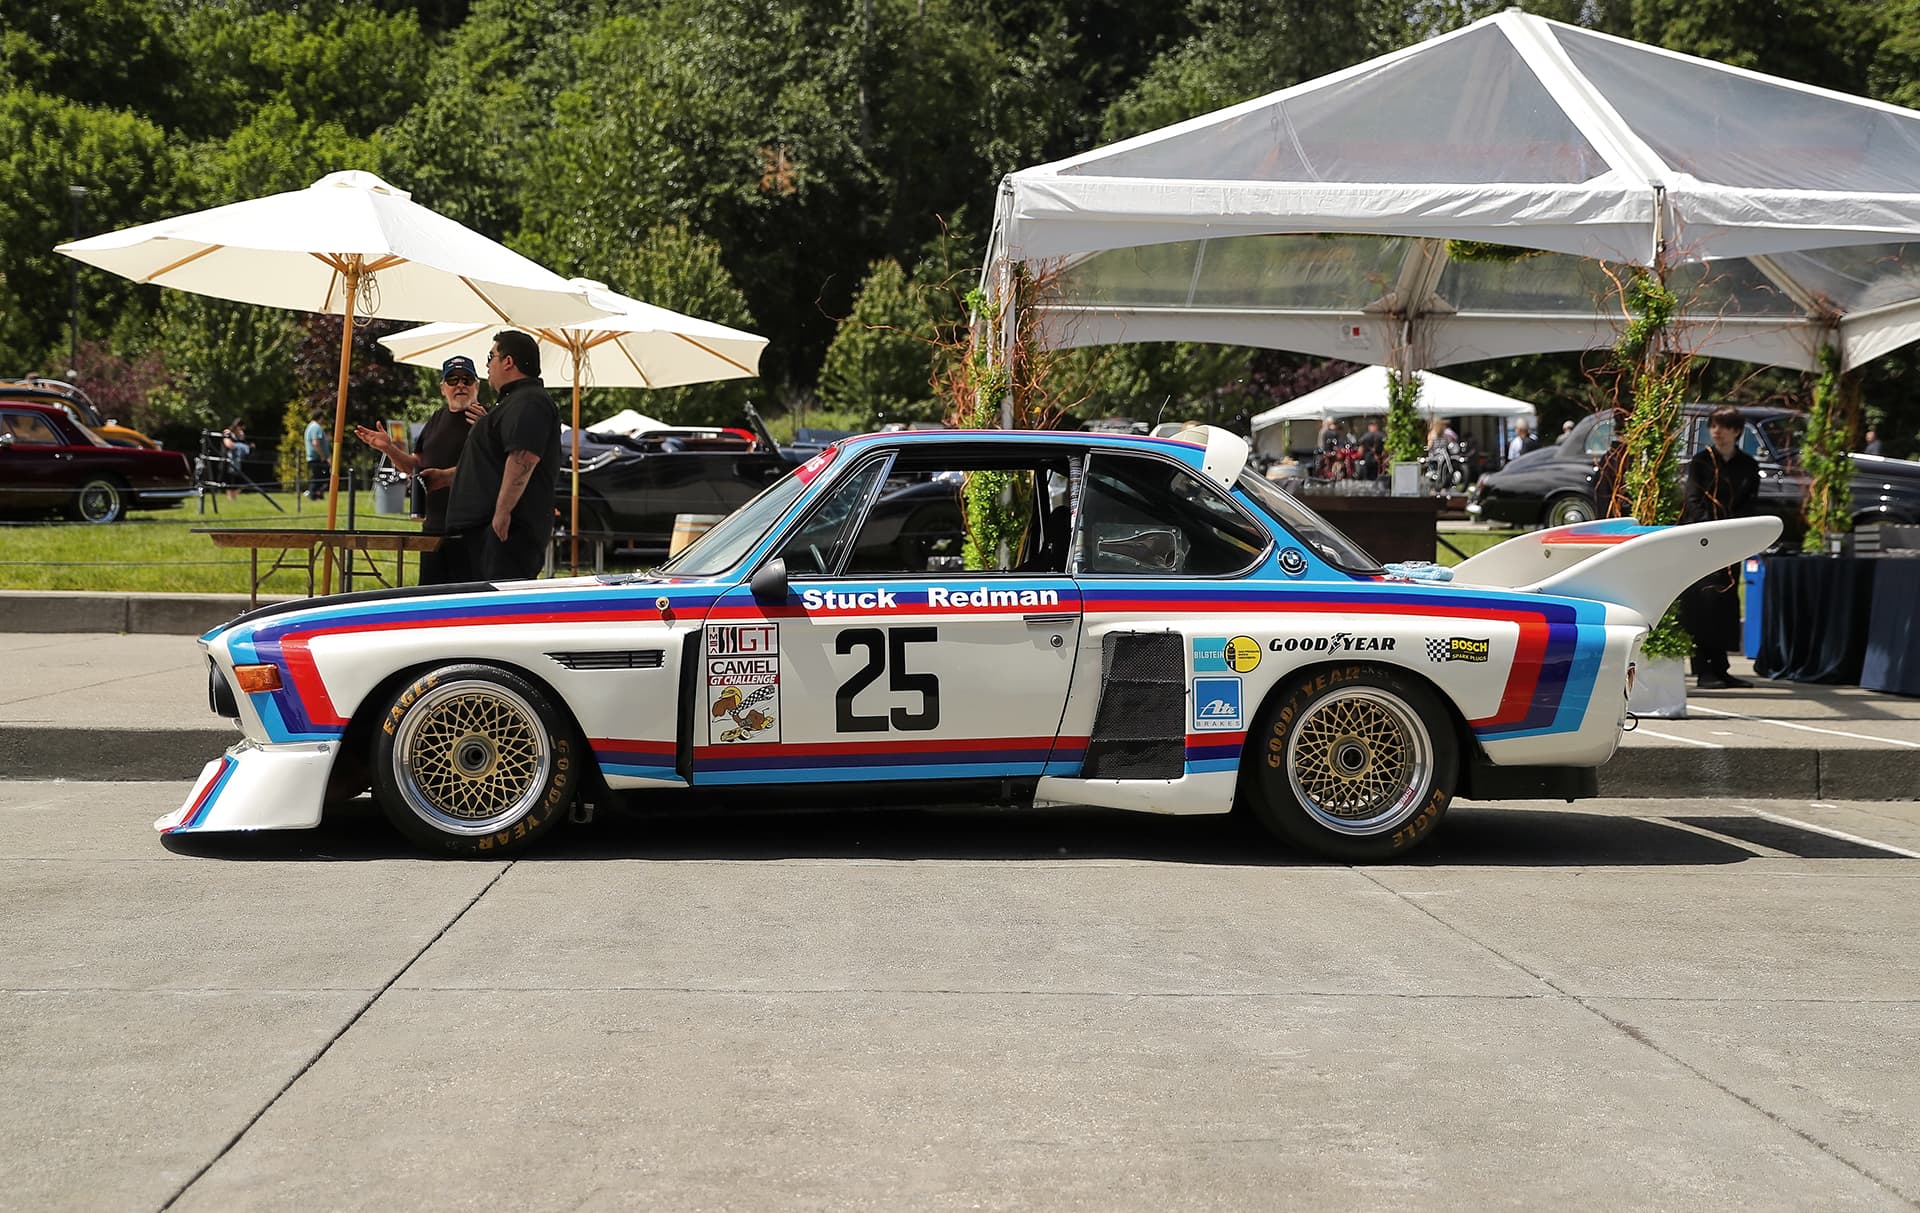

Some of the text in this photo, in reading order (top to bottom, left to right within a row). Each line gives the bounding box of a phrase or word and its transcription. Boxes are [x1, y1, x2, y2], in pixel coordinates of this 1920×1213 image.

[803, 587, 1059, 609] Stuck Redman
[738, 627, 776, 651] GT
[1451, 640, 1487, 652] BOSCH
[1194, 650, 1225, 659] BILSTEIN
[710, 660, 777, 675] CAMEL
[710, 674, 776, 685] GT CHALLENGE
[835, 626, 940, 733] 25
[383, 674, 439, 736] EAGLE
[1392, 788, 1446, 848] EAGLE
